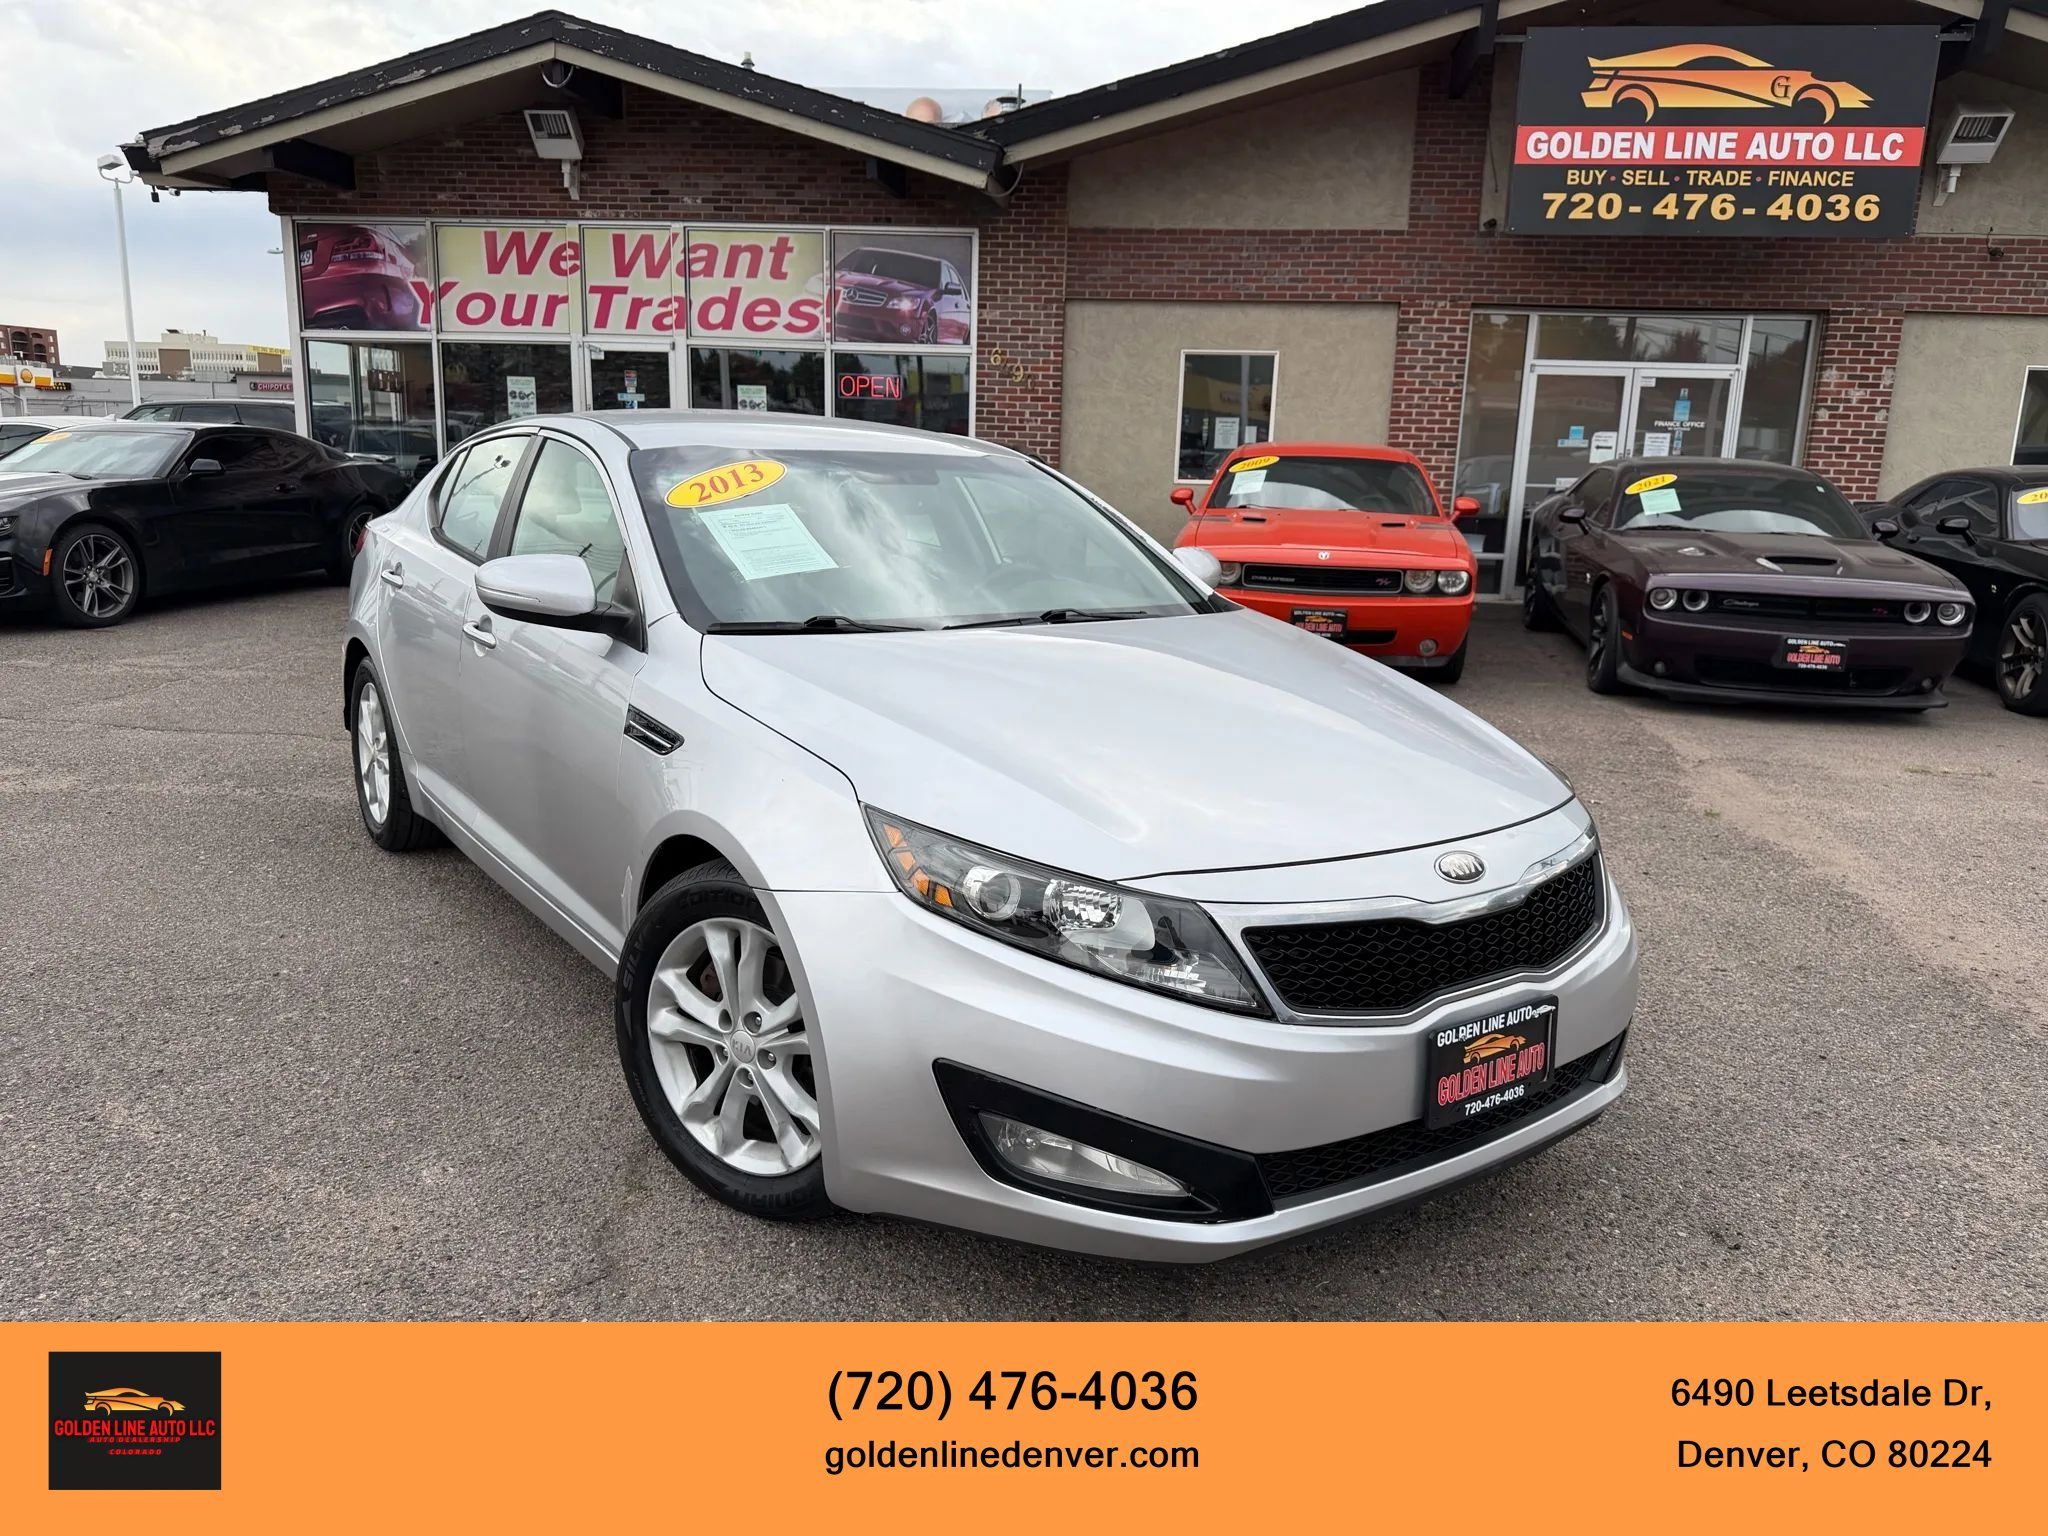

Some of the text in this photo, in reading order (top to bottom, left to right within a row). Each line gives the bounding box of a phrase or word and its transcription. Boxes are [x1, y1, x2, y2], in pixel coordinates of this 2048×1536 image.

[1527, 131, 1904, 161] GOLDEN LINE AUTO LLC
[1566, 169, 1855, 187] BUY SELL TRADE FINANCE
[484, 230, 794, 281] We Want
[409, 281, 842, 334] Your Trades!
[840, 375, 900, 399] OPEN
[690, 463, 764, 502] 2013
[1638, 475, 1666, 490] 2021
[1437, 1005, 1533, 1047] GOLDEN LINE AUTO
[1437, 1042, 1546, 1106] GOLDEN LINE AUTO
[1465, 1085, 1525, 1116] 720-476-4036
